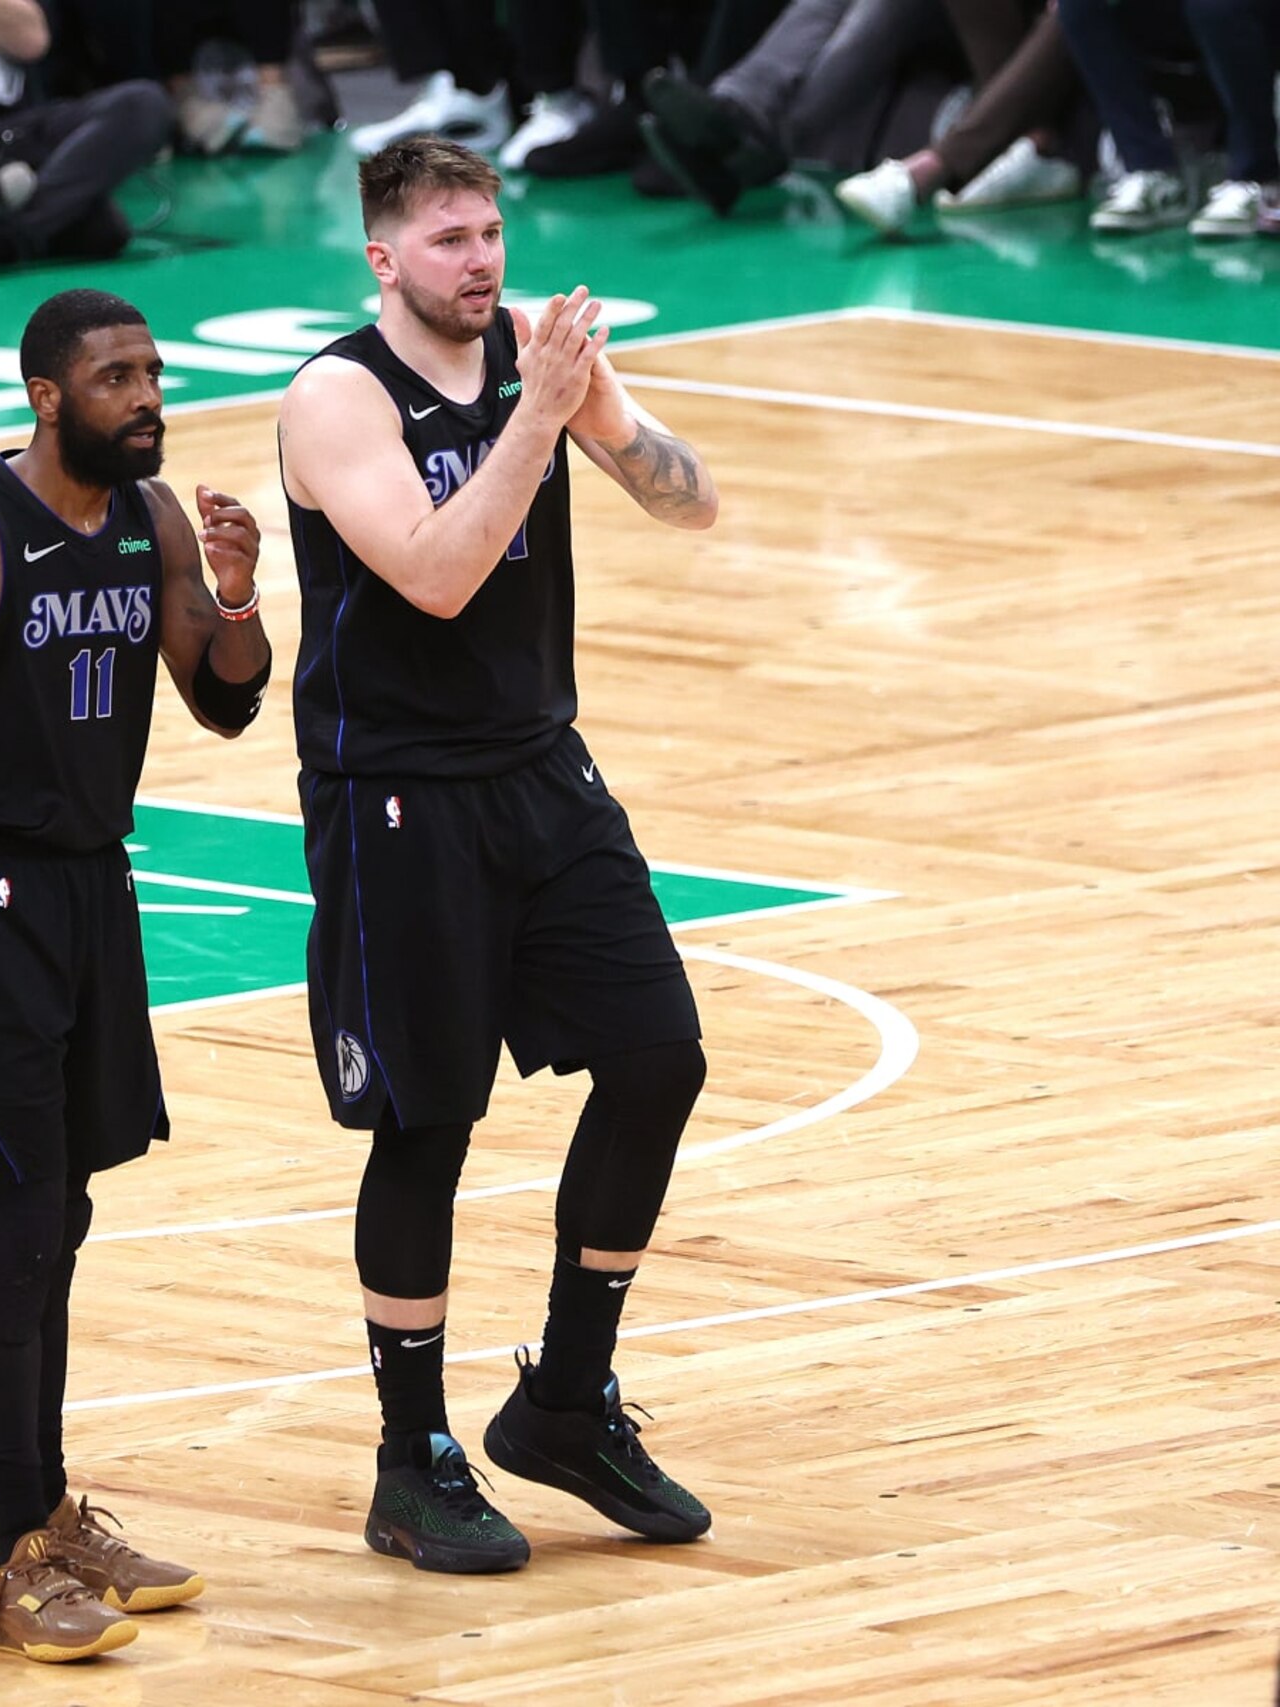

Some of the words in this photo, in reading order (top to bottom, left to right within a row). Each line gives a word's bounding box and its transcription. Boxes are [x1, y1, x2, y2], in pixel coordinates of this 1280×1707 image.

[118, 536, 152, 554] chime
[22, 584, 152, 649] MAVS
[68, 646, 117, 721] 11
